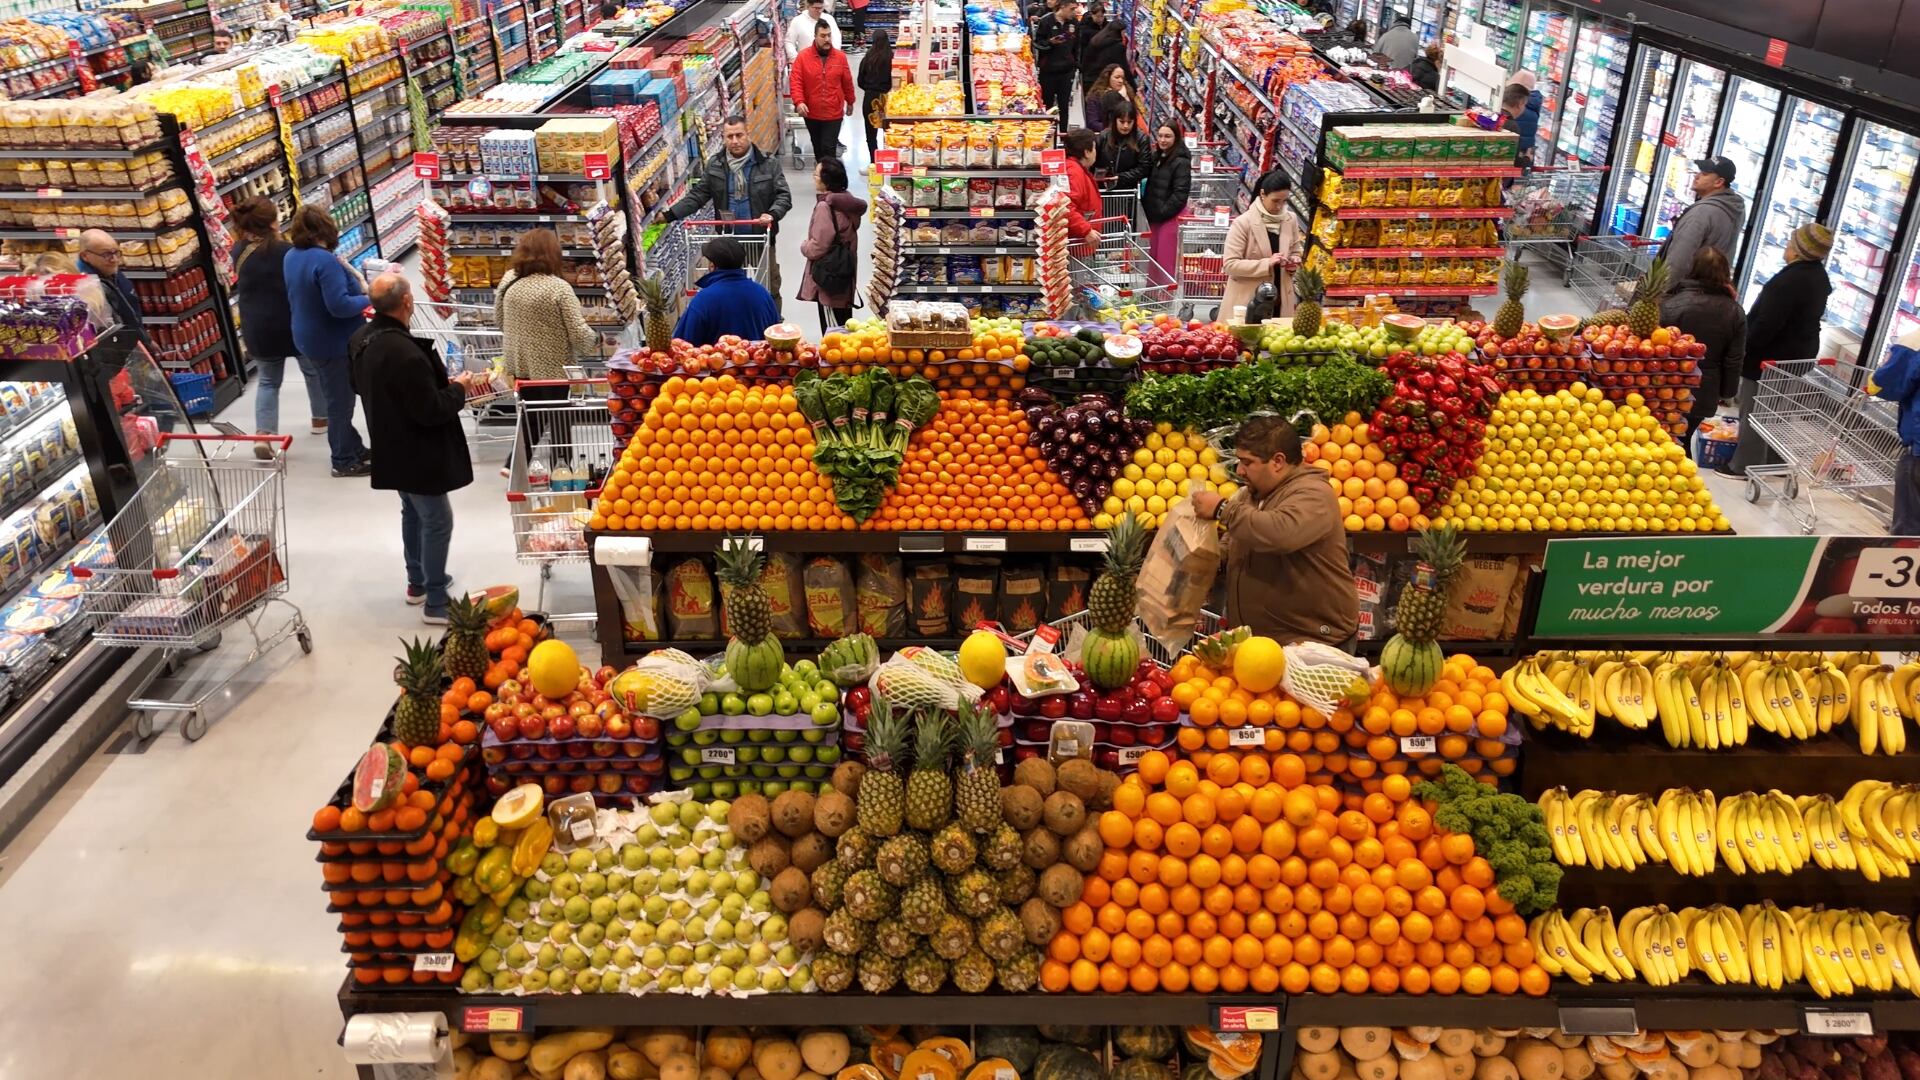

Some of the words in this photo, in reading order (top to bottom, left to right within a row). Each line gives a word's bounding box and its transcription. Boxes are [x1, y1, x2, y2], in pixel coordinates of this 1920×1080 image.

[1583, 551, 1608, 569] La
[1616, 550, 1685, 572] mejor
[1868, 555, 1920, 588] -3
[1577, 575, 1664, 596] verdura
[1672, 578, 1713, 598] por
[1567, 598, 1641, 621] mucho
[1649, 601, 1721, 621] menos
[1852, 600, 1901, 614] Todos
